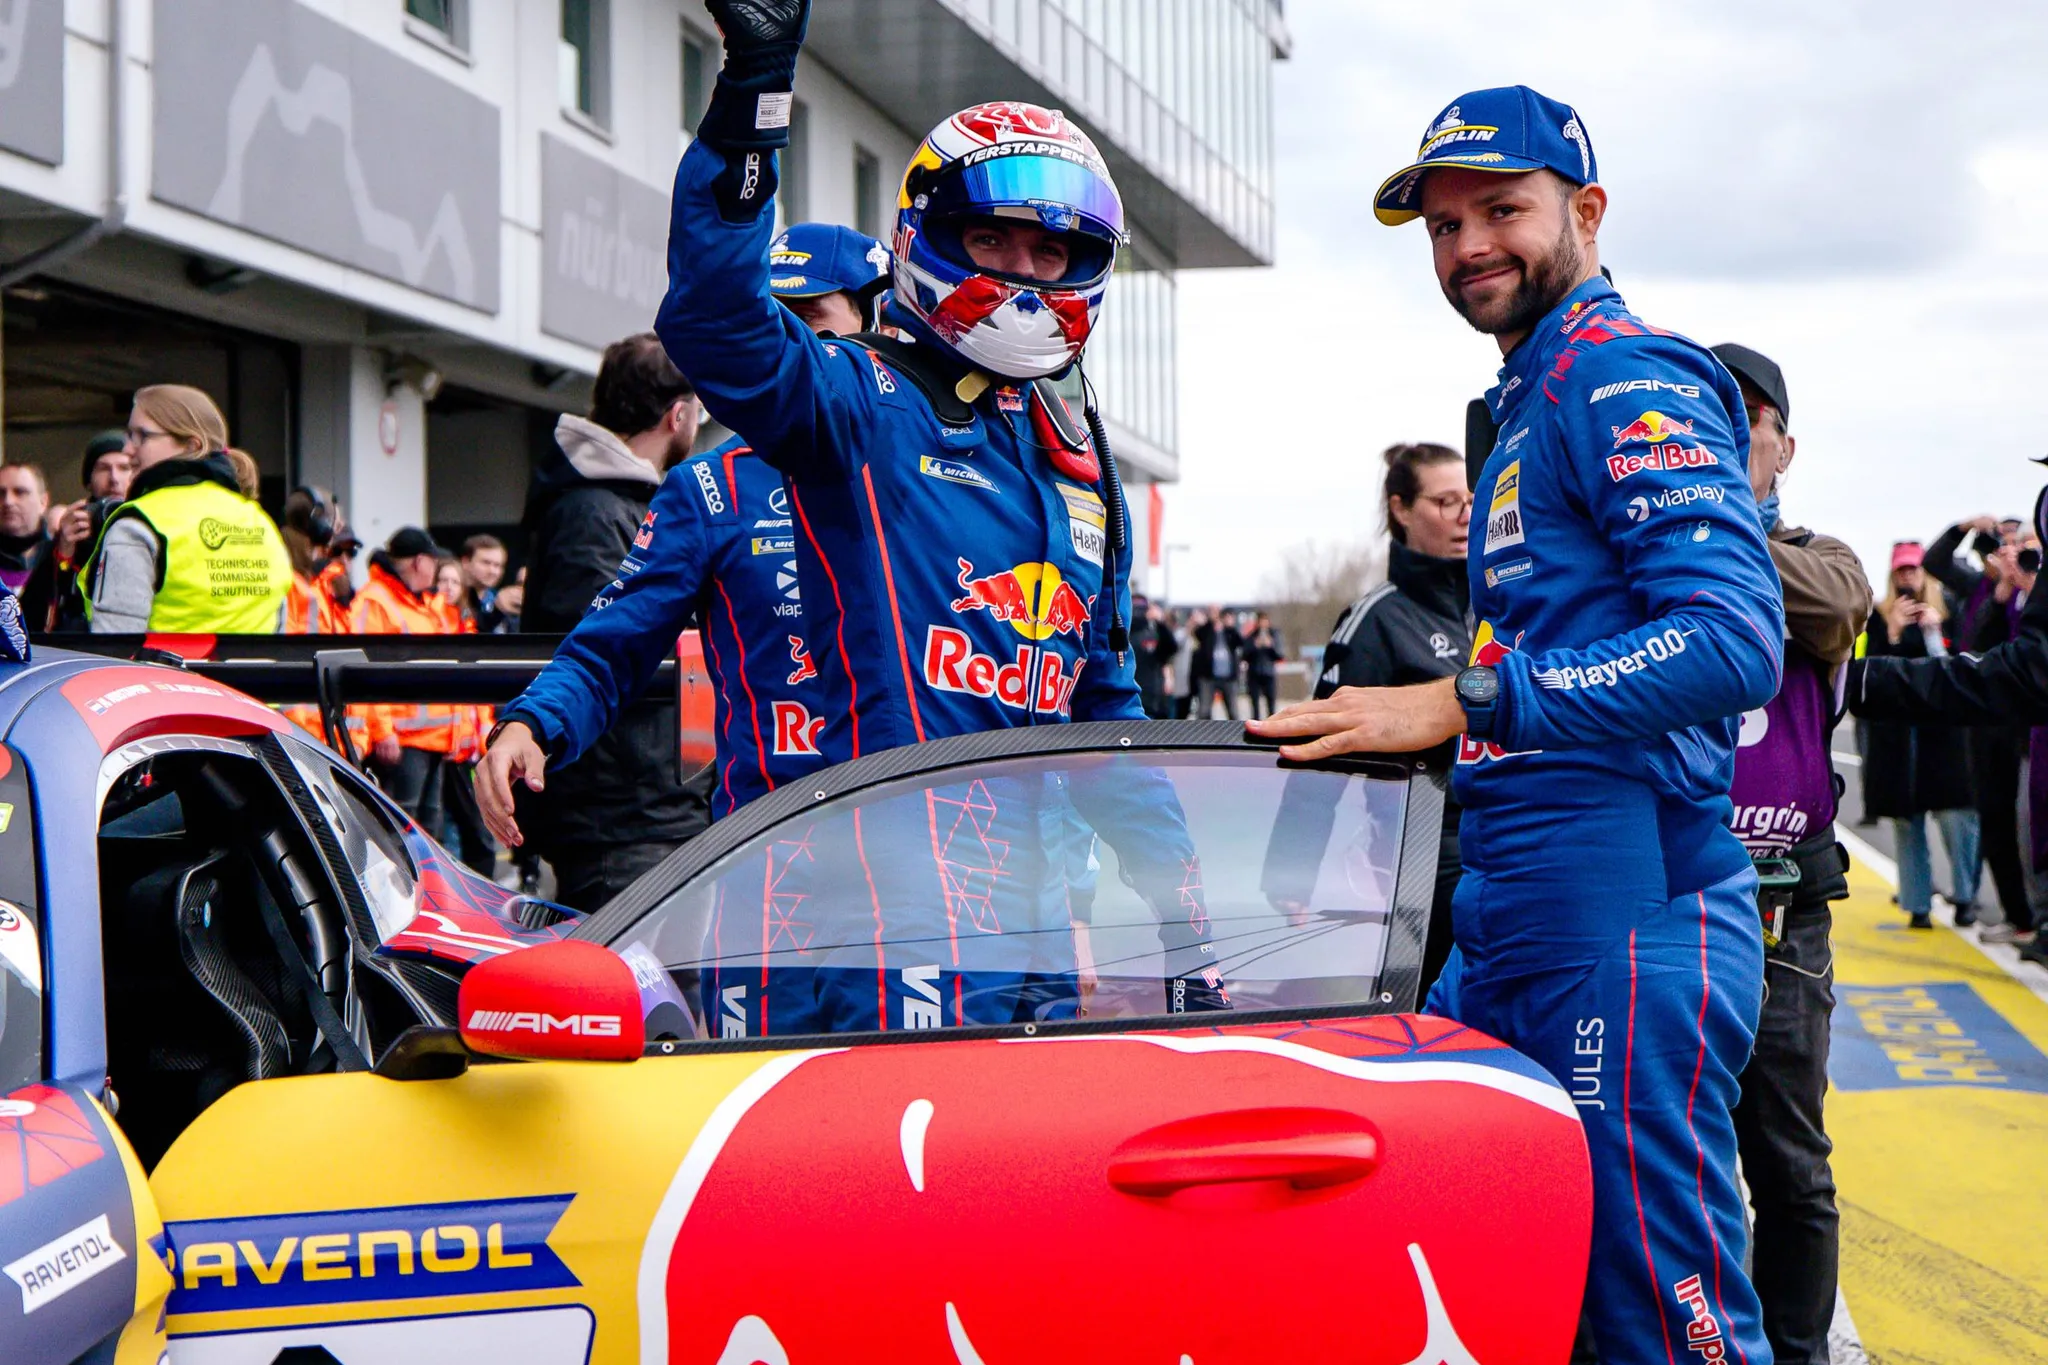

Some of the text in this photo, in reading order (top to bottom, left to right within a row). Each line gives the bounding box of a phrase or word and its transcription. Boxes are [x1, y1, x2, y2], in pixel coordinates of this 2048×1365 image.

[740, 153, 760, 199] arco
[693, 461, 725, 515] sparco
[1652, 484, 1725, 509] viaplay
[204, 559, 269, 570] TECHNISCHER
[209, 572, 269, 583] KOMMISSAR
[1497, 562, 1531, 577] MICHELIN
[210, 586, 271, 597] SCRUTINEER
[773, 602, 802, 618] viap
[923, 624, 1033, 710] Red
[1560, 650, 1648, 690] Player
[1173, 979, 1186, 1014] spar
[508, 1012, 621, 1036] AMG
[1572, 1017, 1606, 1111] JULES
[20, 1234, 111, 1295] RAVENOL
